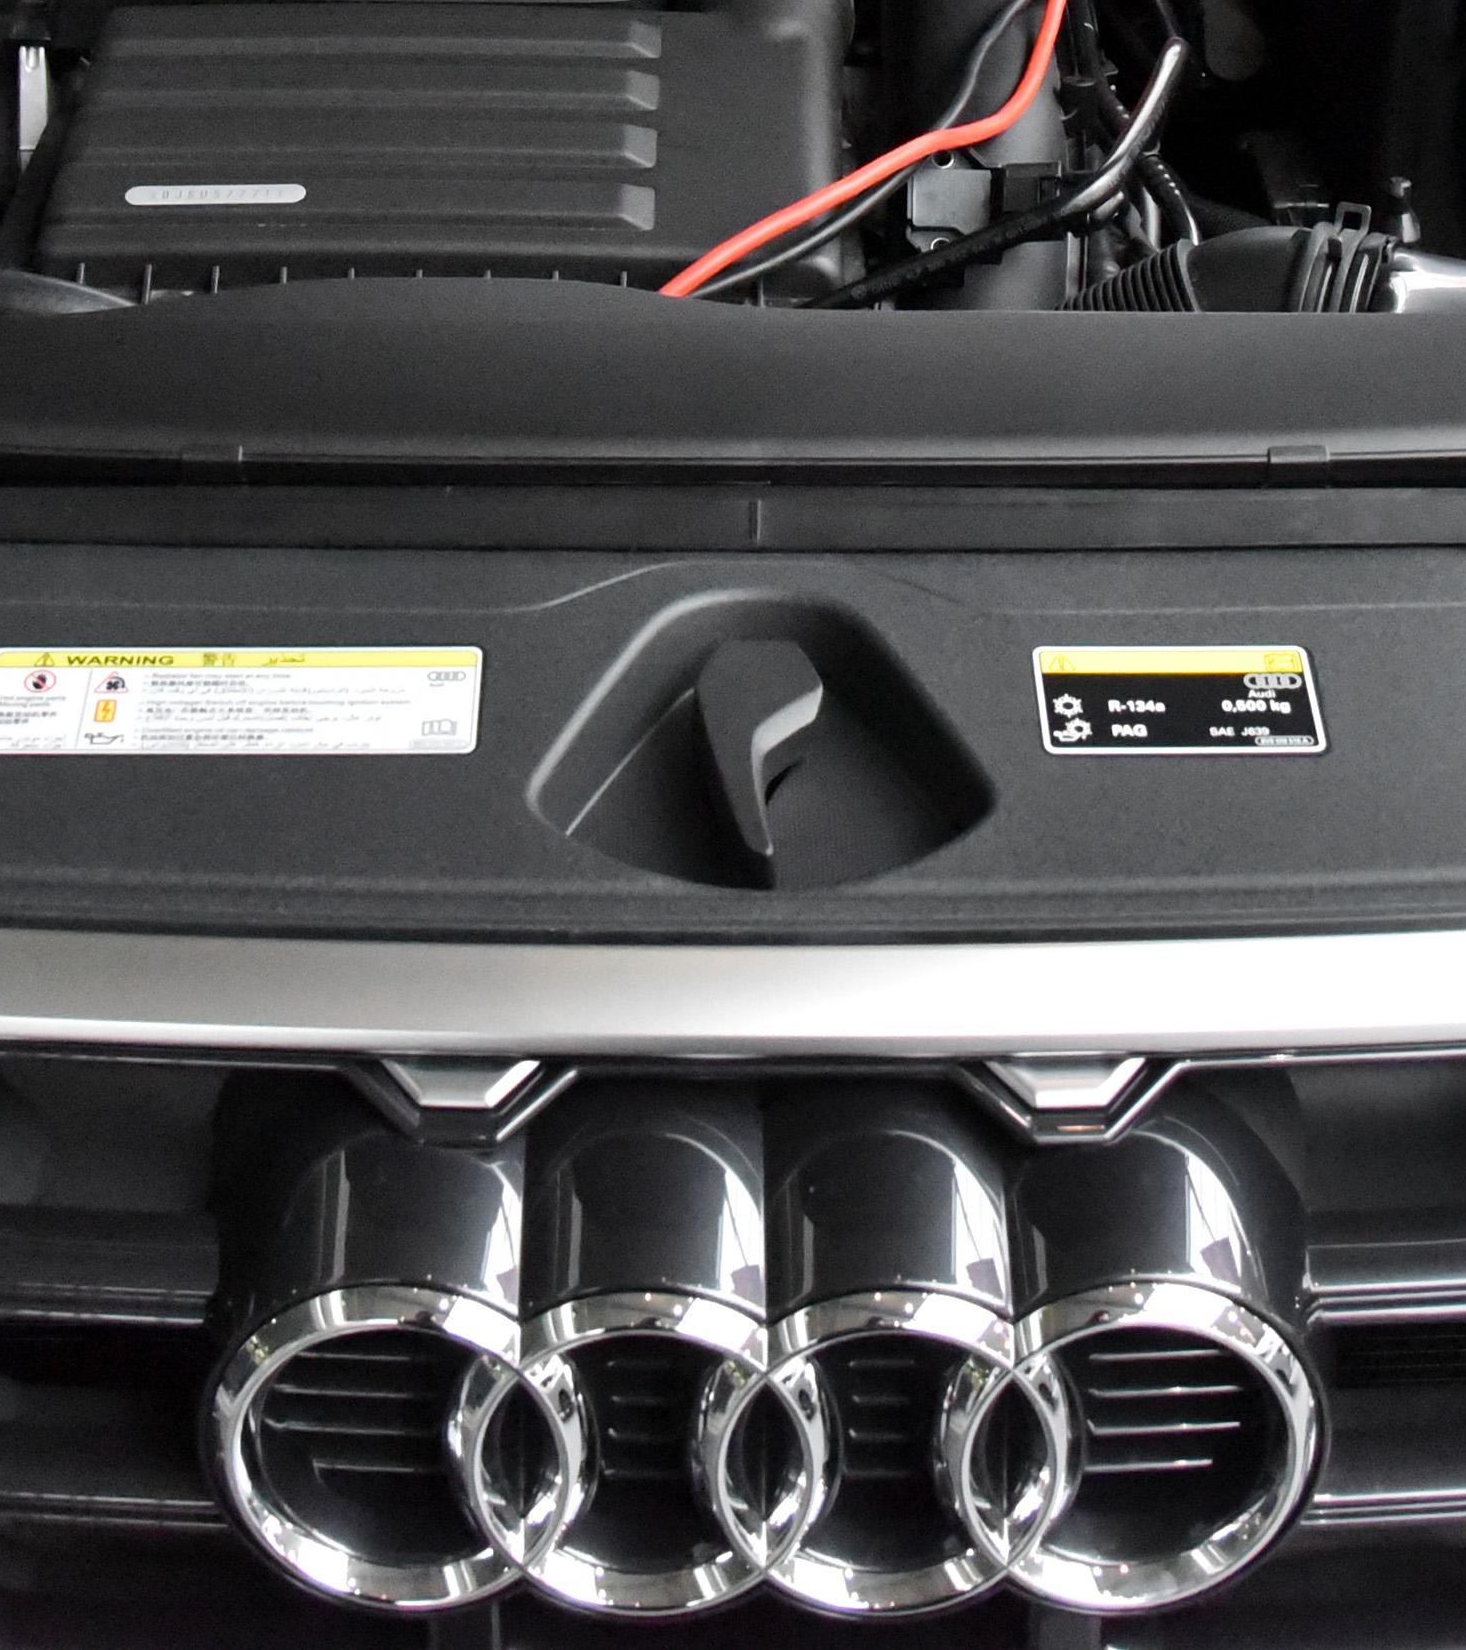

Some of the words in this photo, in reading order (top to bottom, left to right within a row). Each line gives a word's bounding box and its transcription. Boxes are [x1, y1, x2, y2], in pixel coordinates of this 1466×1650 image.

[67, 654, 174, 667] WARNING
[1247, 689, 1276, 700] Audi
[1107, 699, 1166, 713] R-134a
[1269, 699, 1292, 715] kg
[1111, 723, 1148, 738] PAG
[1209, 726, 1236, 737] SAE
